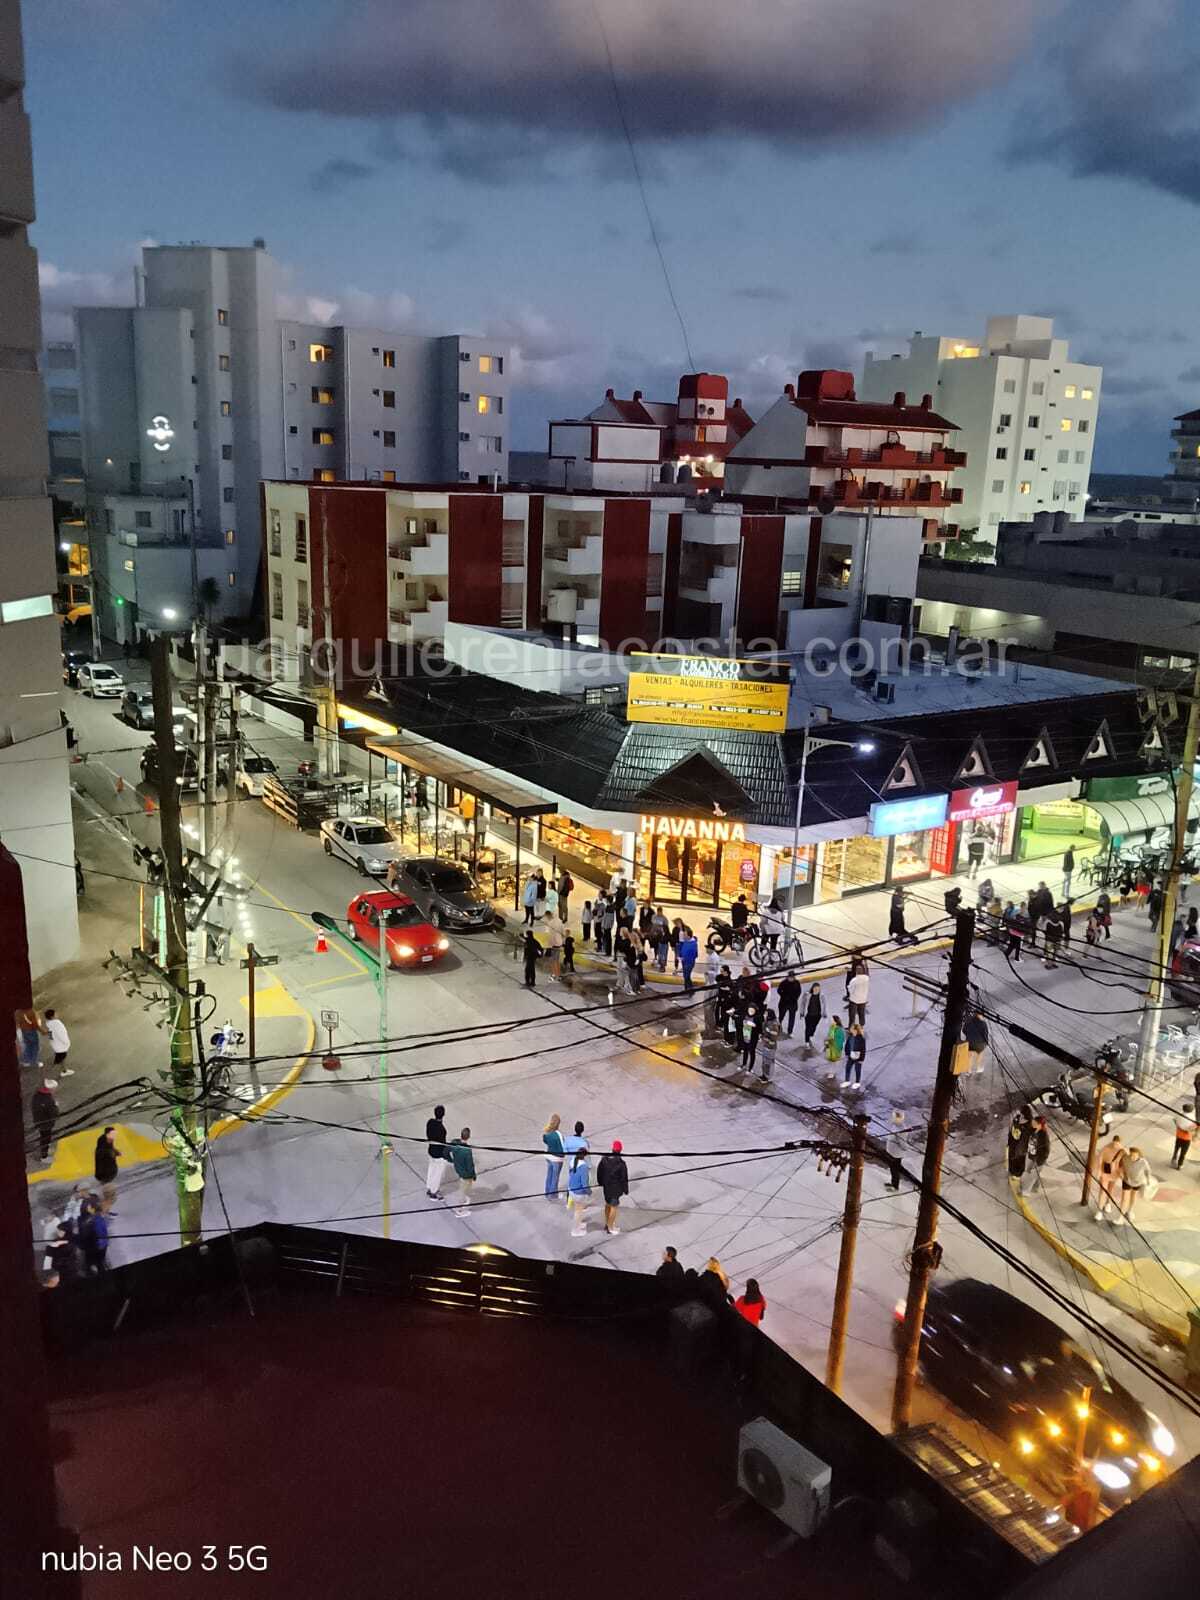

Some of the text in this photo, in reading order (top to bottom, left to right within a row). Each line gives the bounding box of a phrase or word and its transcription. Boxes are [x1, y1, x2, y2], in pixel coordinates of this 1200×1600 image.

[680, 659, 740, 674] FRANCO
[645, 676, 673, 686] VENTAS
[680, 680, 724, 690] ALQUILERES
[730, 684, 774, 694] TASACIONES
[640, 815, 746, 842] HAVANNA
